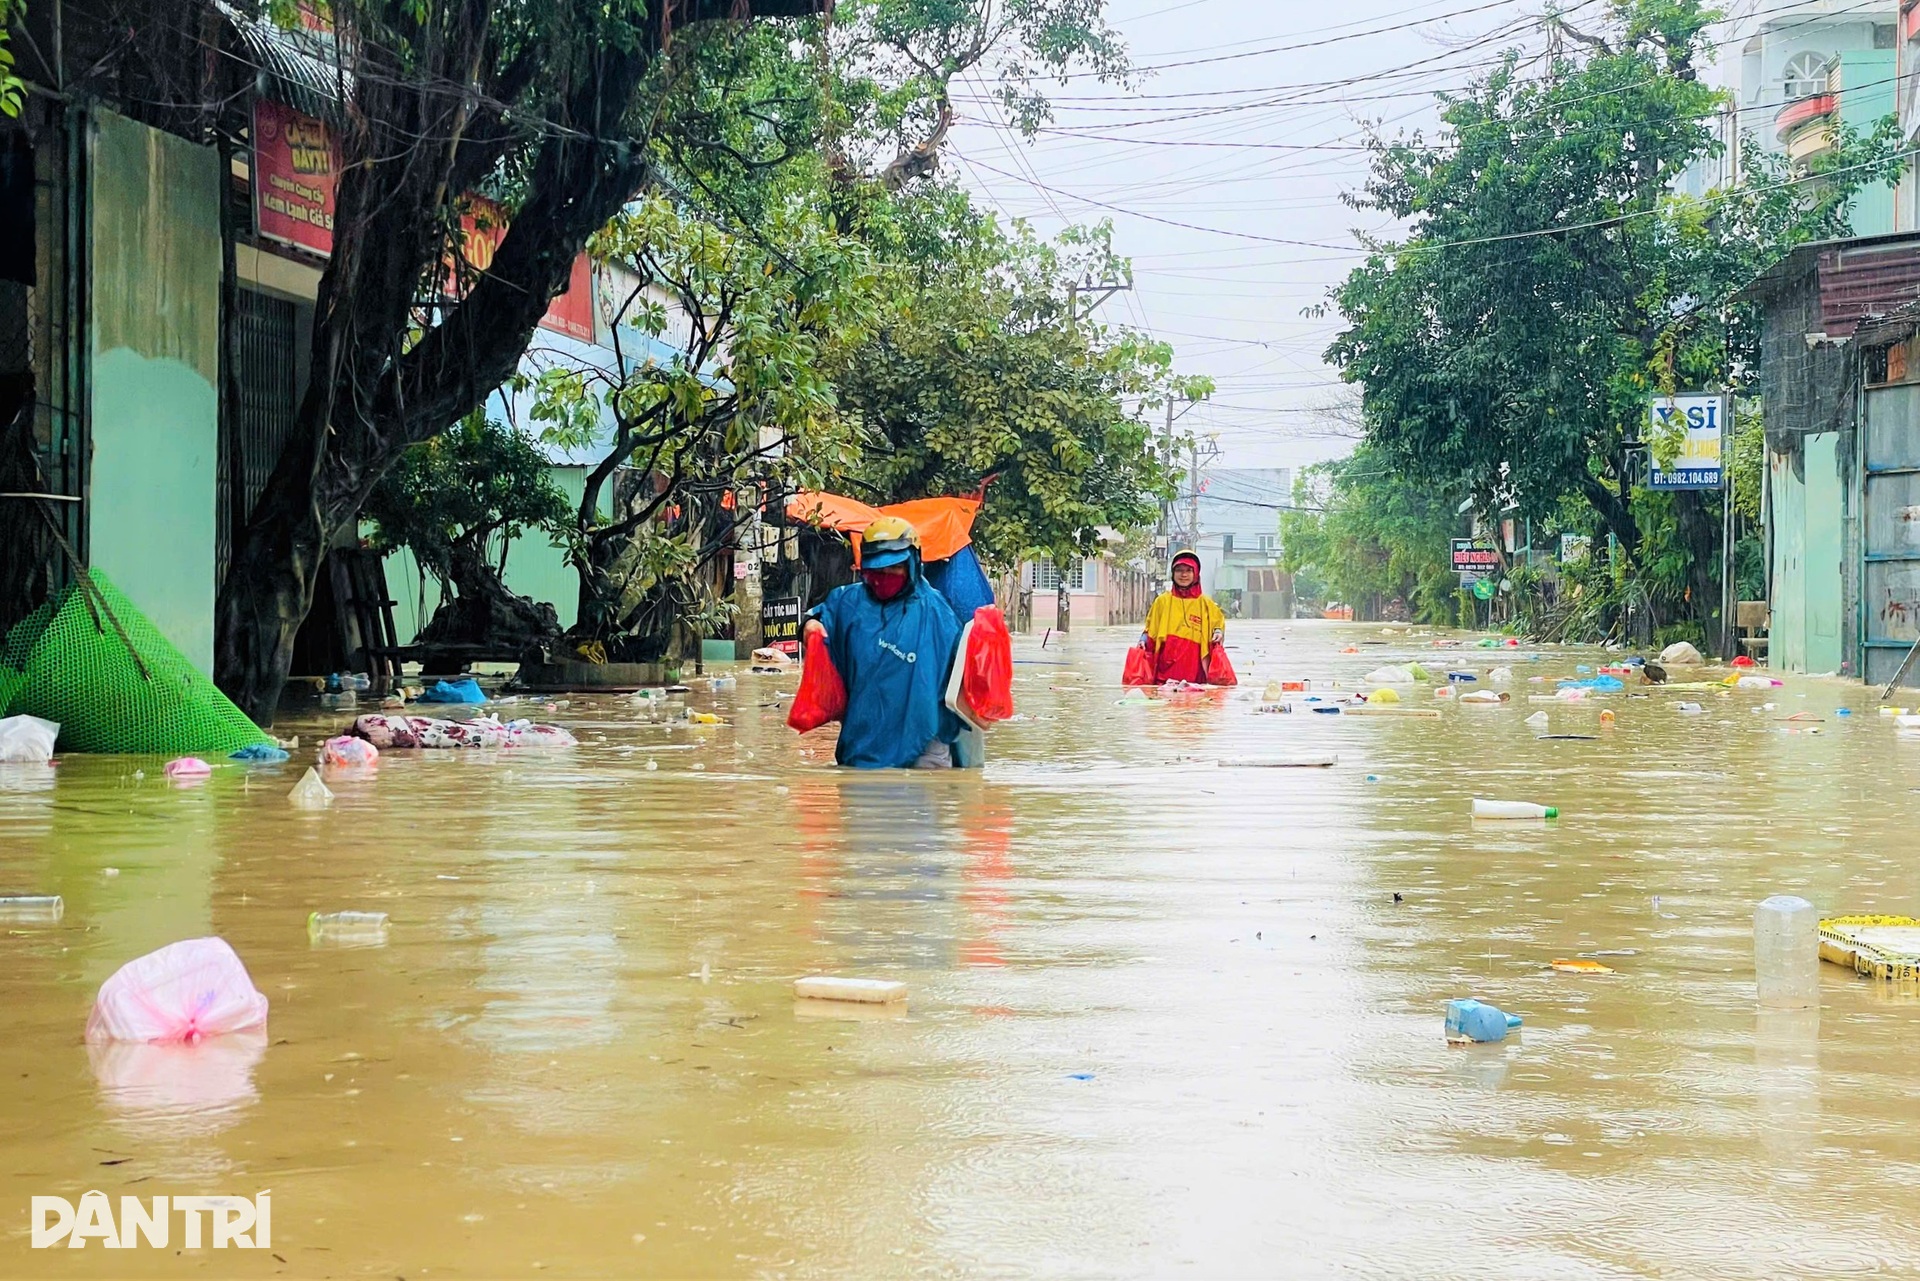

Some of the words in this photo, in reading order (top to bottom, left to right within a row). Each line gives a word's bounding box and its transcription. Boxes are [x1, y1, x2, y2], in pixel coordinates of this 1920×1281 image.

[263, 191, 285, 213] Kem
[286, 200, 308, 221] Lạnh
[309, 208, 324, 227] Giá
[1687, 400, 1717, 429] SĨ
[1654, 473, 1666, 485] ĐT:
[1668, 472, 1718, 485] 0982.104.689
[748, 563, 759, 571] 02
[774, 603, 785, 617] TÓC
[785, 604, 797, 616] NAM
[782, 622, 797, 636] ART
